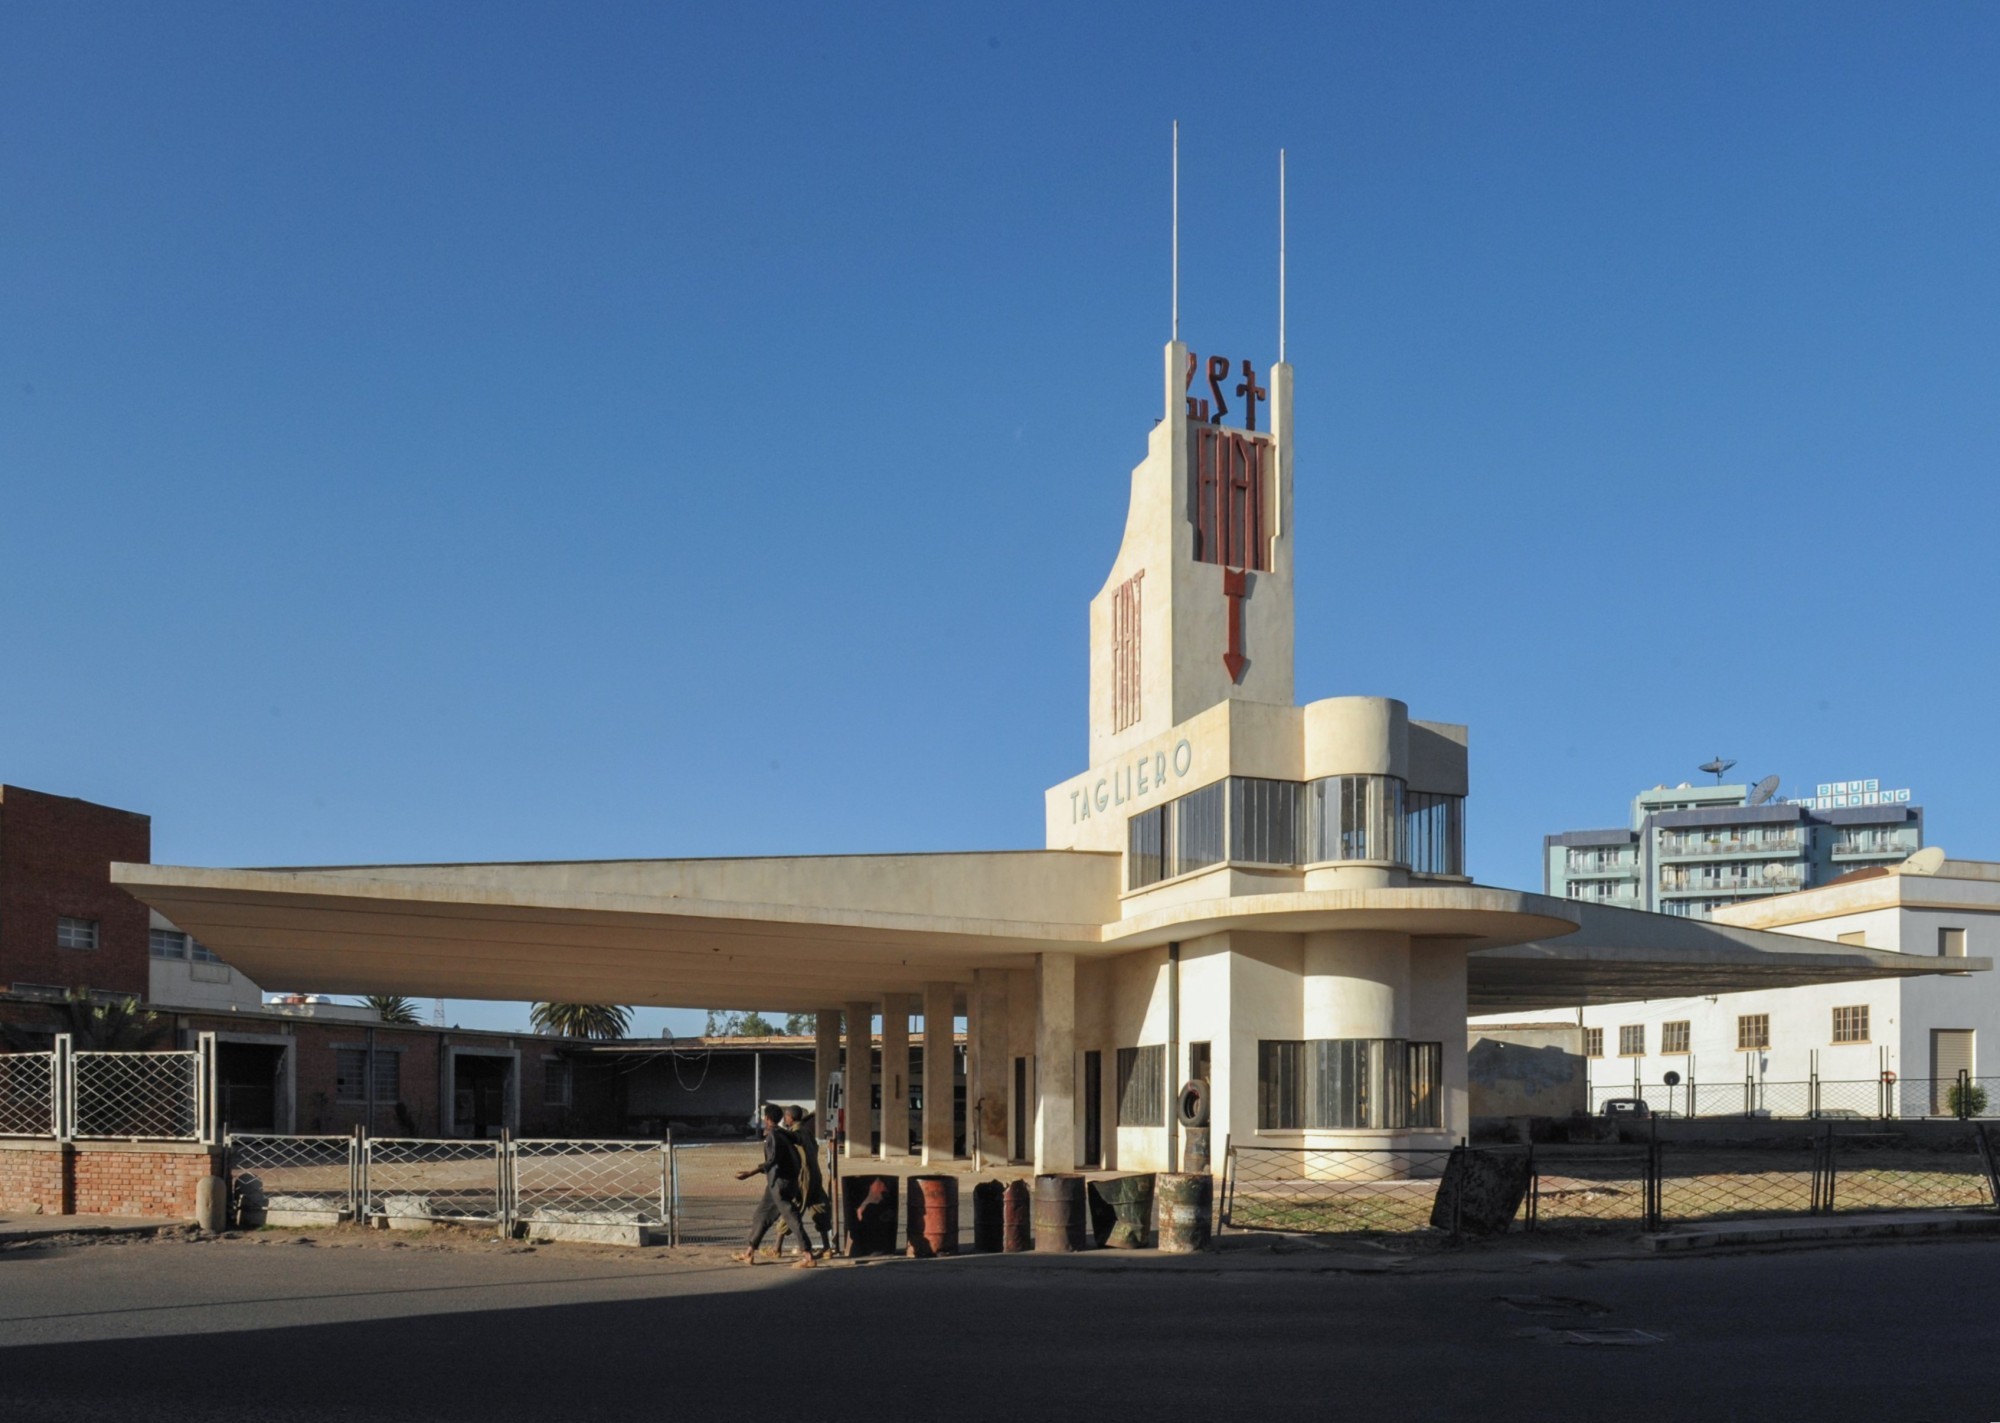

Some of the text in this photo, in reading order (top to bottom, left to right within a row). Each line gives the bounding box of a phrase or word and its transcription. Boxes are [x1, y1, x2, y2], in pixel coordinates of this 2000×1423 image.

[1197, 428, 1268, 571] FIAT
[1111, 568, 1145, 735] FIAT
[1070, 738, 1192, 825] TAGLIERO
[1819, 780, 1878, 796] BLUE
